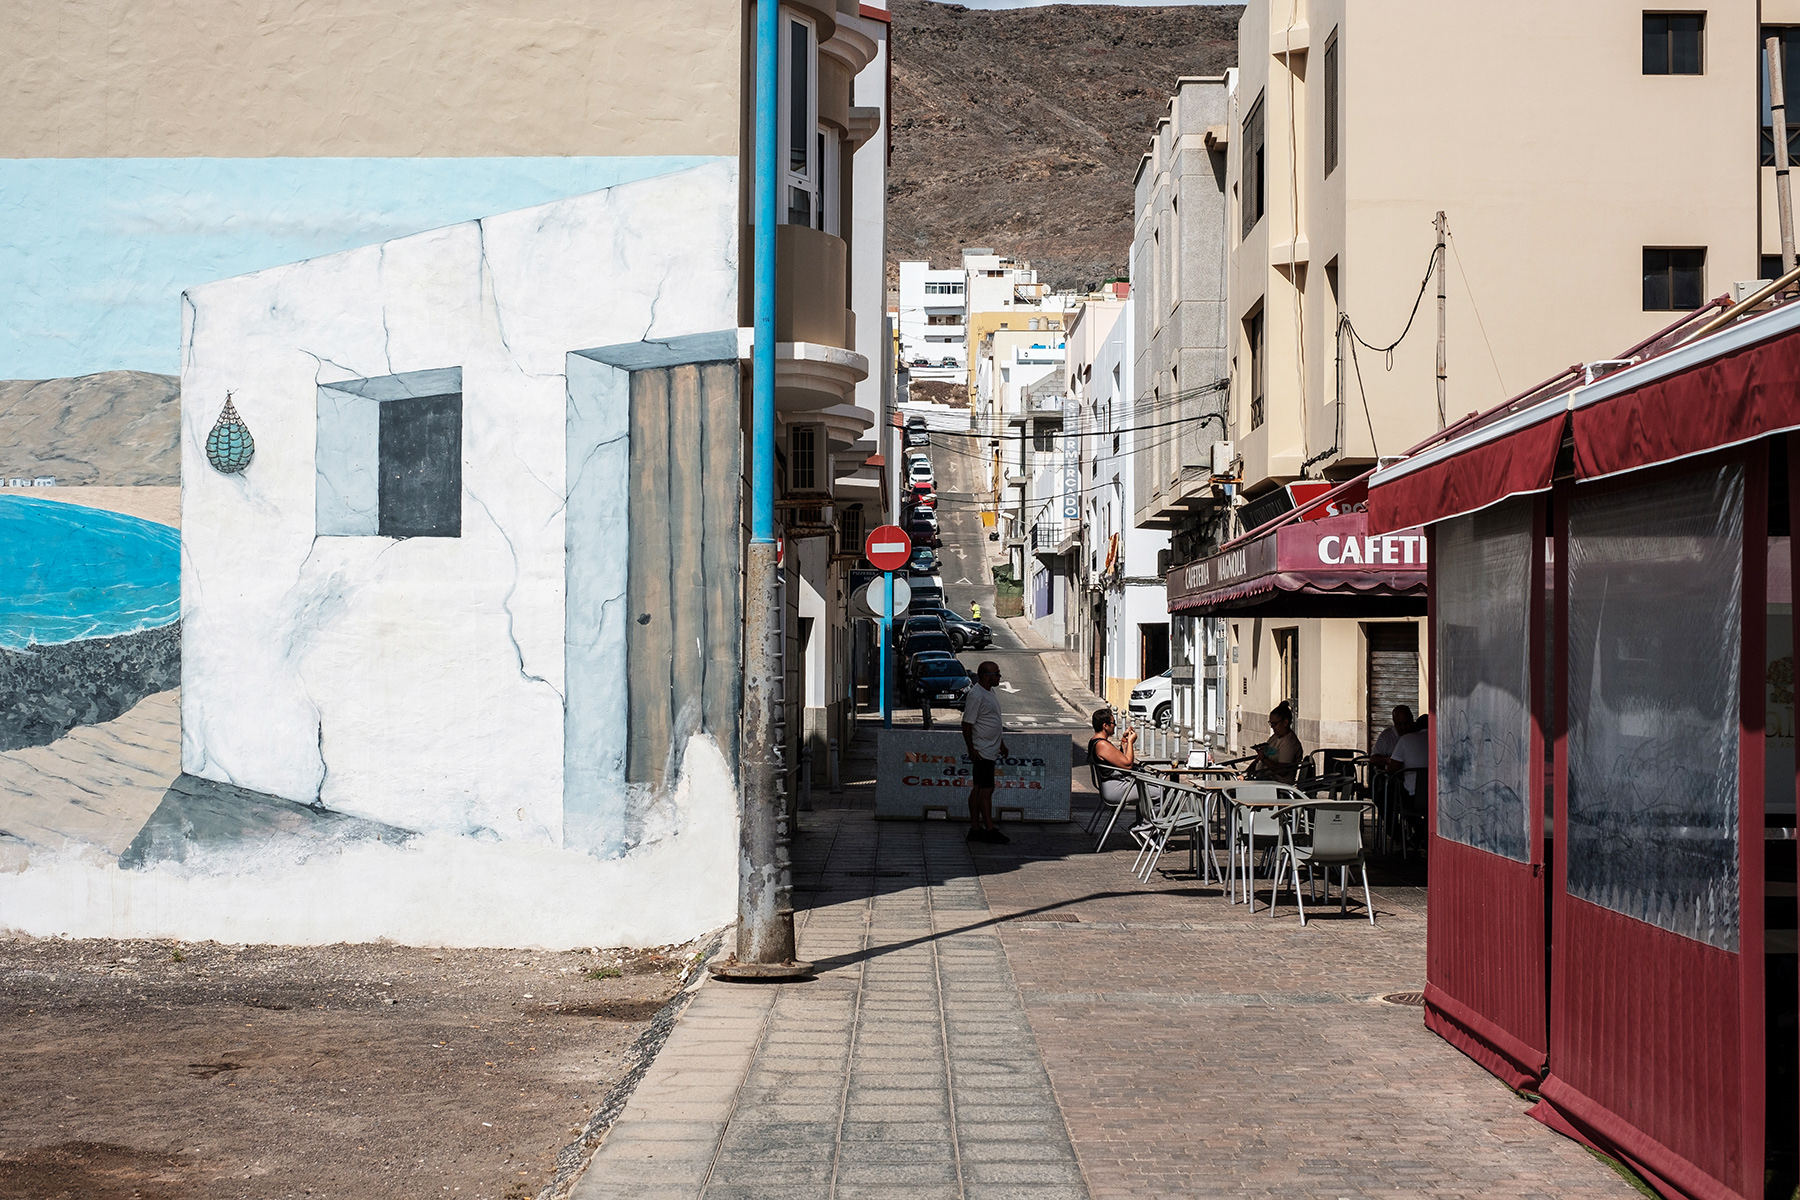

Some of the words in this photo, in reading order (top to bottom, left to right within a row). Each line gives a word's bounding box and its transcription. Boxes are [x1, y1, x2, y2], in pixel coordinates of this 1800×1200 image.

[1065, 402, 1078, 515] SUPERMERCADO
[1185, 562, 1210, 590] CAFETERIA
[1217, 549, 1247, 581] MAGNOLIA
[903, 752, 957, 764] Ntra
[943, 766, 970, 776] de
[902, 775, 1042, 789] Candearia
